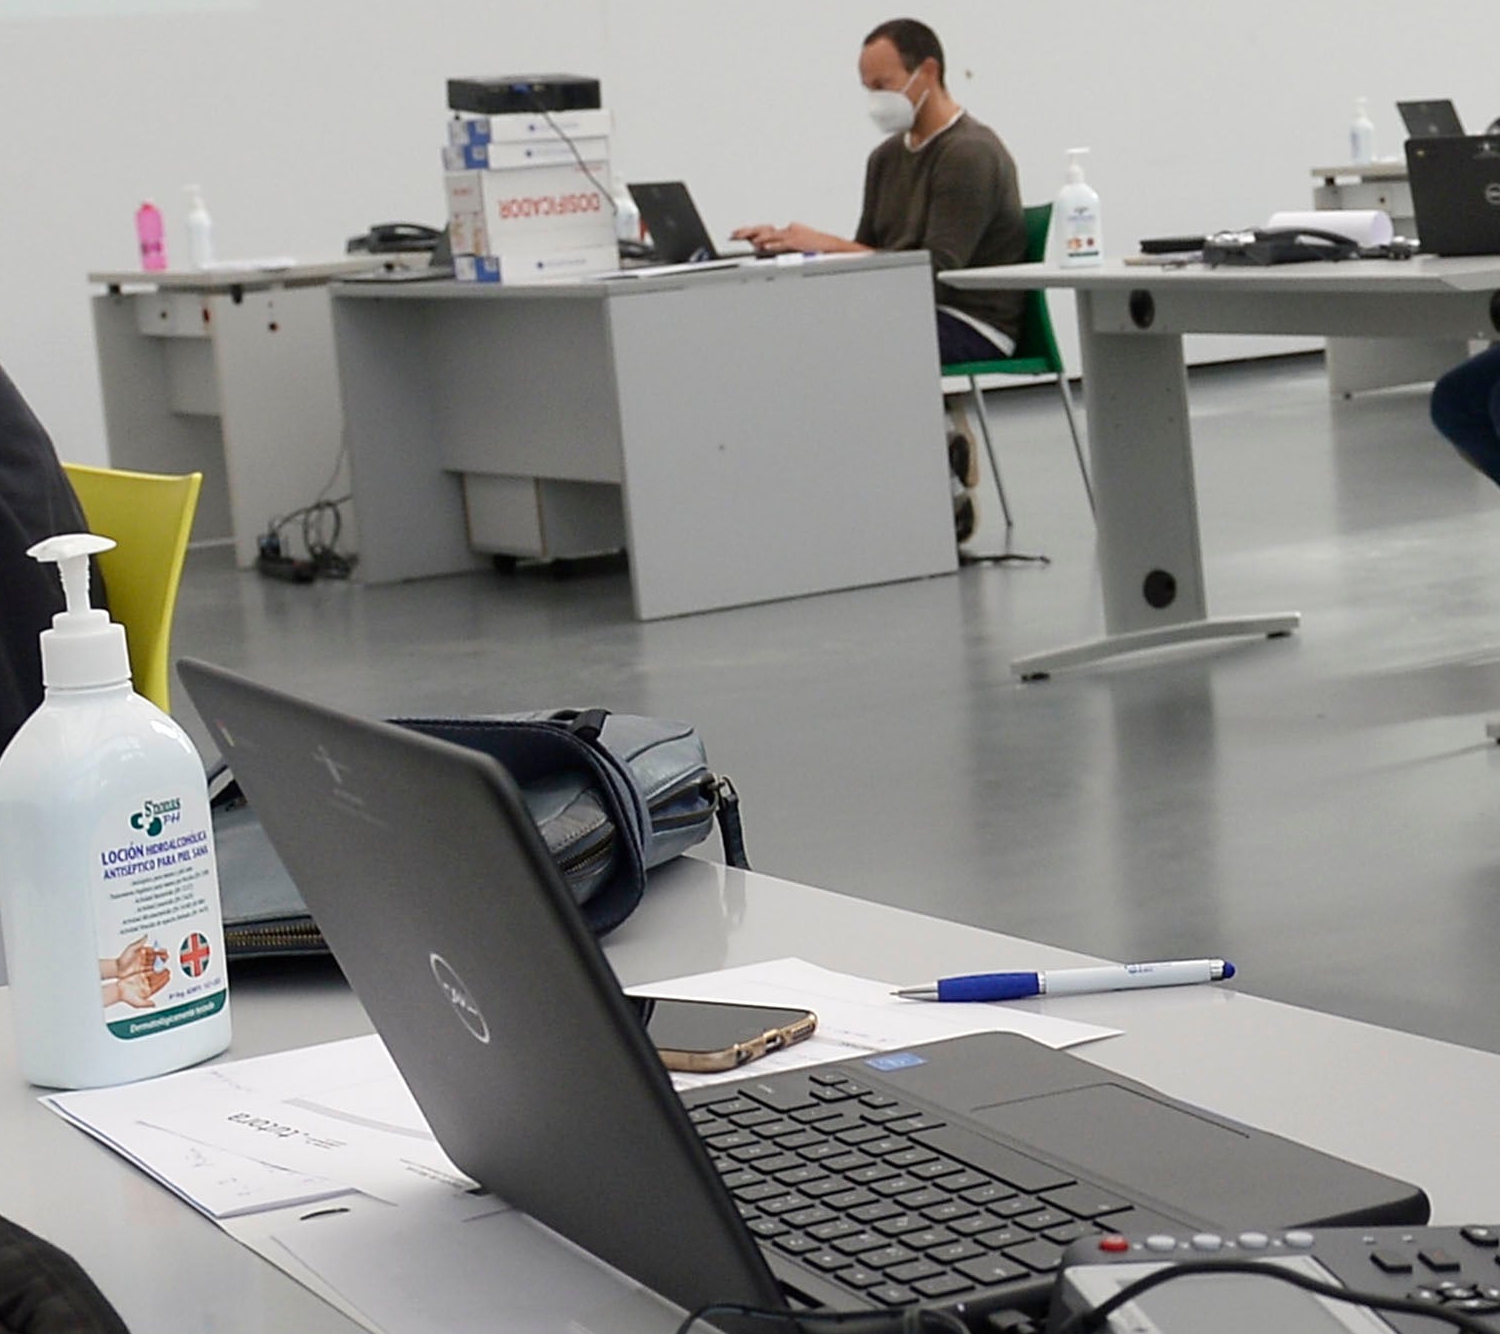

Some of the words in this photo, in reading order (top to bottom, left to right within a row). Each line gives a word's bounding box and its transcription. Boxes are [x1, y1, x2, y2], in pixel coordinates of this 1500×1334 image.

[499, 191, 601, 220] DOSIFICADOR
[101, 841, 145, 866] LOCIÓN
[145, 830, 208, 856] HIDROALCOHÓLICA
[103, 859, 156, 881] ANTISÉPTICO
[157, 854, 177, 869] PARA
[177, 850, 192, 864] PIEL
